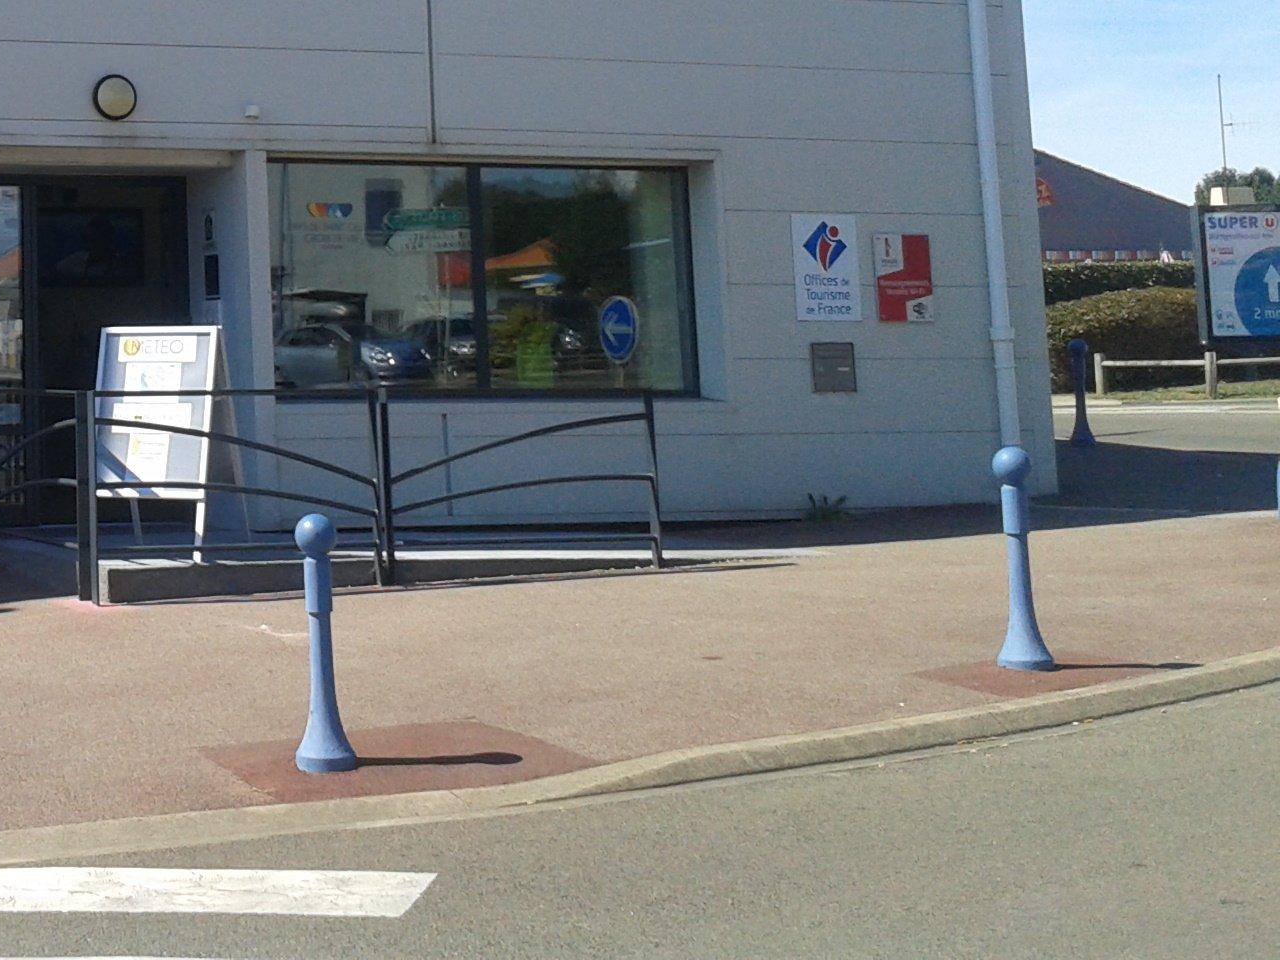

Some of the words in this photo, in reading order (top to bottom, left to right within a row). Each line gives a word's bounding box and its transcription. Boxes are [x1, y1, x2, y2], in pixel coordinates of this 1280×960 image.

[1207, 215, 1259, 230] SUPER
[1265, 217, 1275, 228] U
[803, 273, 839, 287] Offices
[805, 288, 851, 301] Tourisme
[817, 302, 852, 316] France
[1253, 306, 1261, 319] 2
